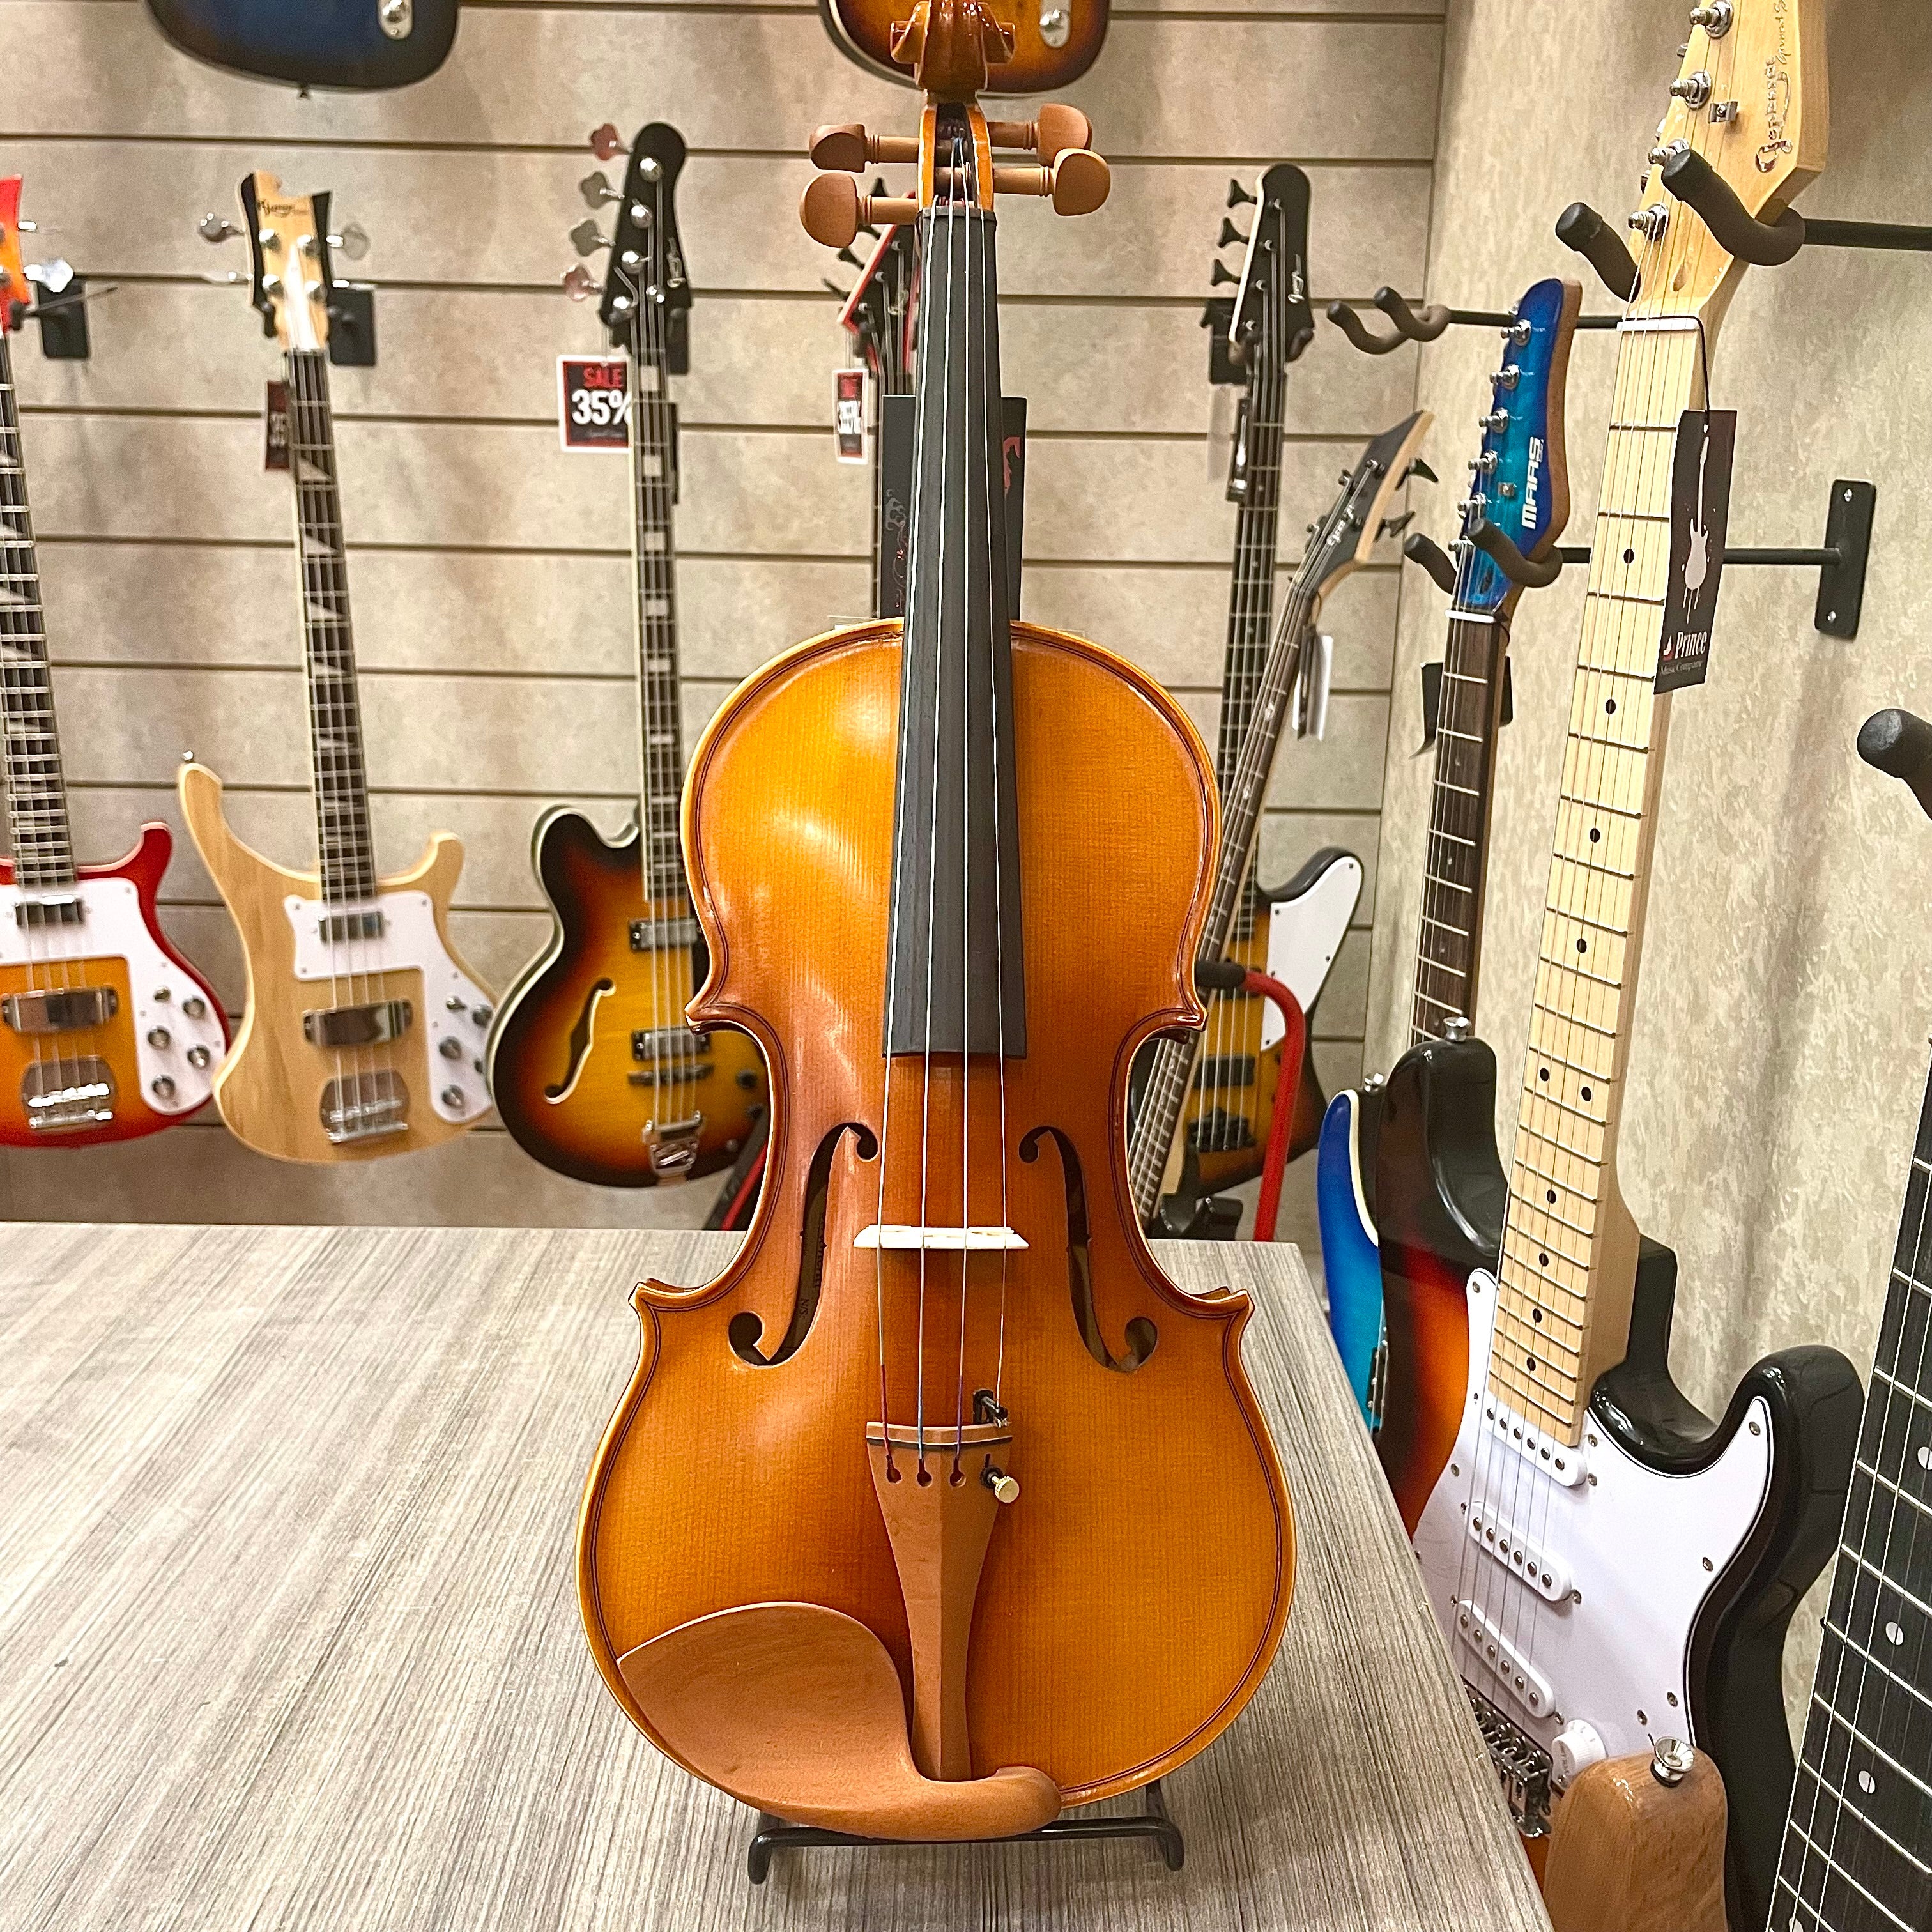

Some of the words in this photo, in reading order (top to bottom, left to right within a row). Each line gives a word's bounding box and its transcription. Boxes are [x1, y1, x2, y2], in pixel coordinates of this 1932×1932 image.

[583, 367, 624, 388] SALE
[571, 389, 632, 425] 35%
[1674, 631, 1707, 659] Prince
[1676, 661, 1703, 672] Company
